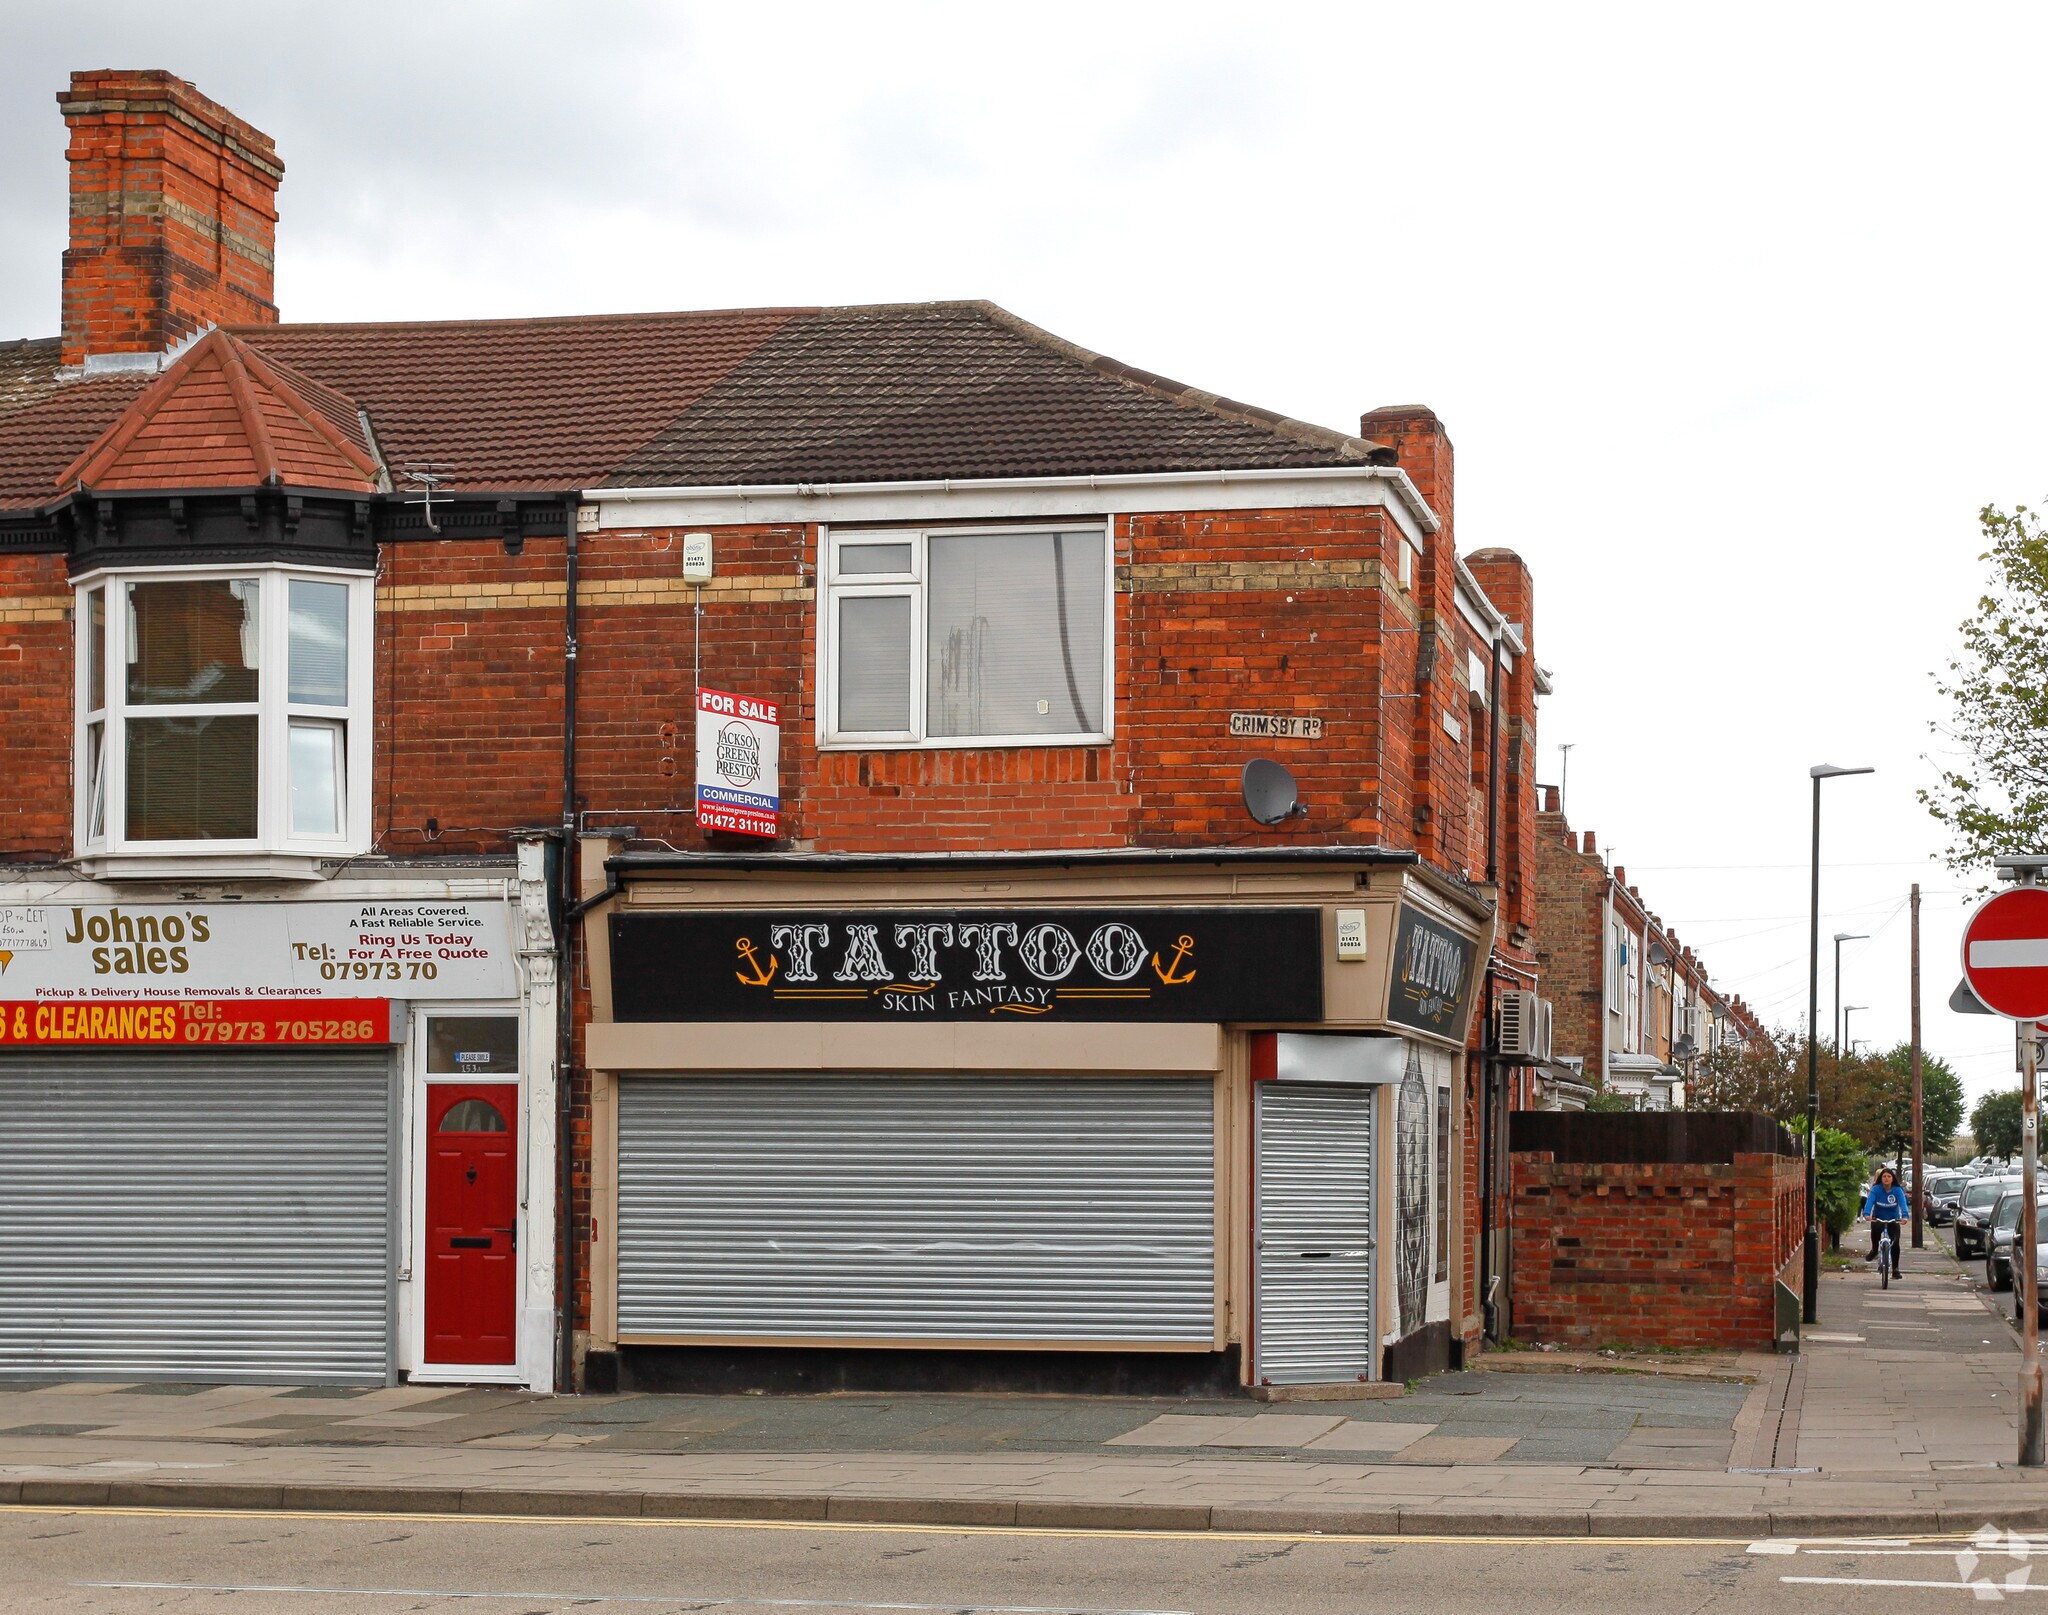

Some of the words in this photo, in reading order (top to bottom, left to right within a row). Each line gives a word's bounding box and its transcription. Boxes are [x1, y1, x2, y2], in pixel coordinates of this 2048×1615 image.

[702, 692, 734, 713] FOR
[739, 700, 777, 722] SALE
[717, 730, 760, 750] JACKSON
[716, 760, 761, 781] PRESTON
[703, 788, 773, 809] COMMERCIAL
[701, 813, 735, 829] 01472
[739, 818, 776, 835] 311120
[27, 909, 44, 922] LET
[361, 907, 376, 916] All
[380, 907, 414, 916] Areas
[417, 906, 469, 916] Covered.
[65, 907, 210, 943] Johno's
[349, 919, 358, 927] A
[362, 919, 385, 928] Fast
[389, 918, 433, 927] Reliable
[438, 918, 484, 927] Service.
[359, 934, 395, 947] Ring
[401, 934, 420, 945] Us
[426, 933, 473, 947] Today
[92, 943, 189, 974] sales
[292, 943, 336, 960] Tel:
[349, 949, 374, 959] For
[380, 949, 392, 959] A
[398, 948, 432, 959] Free
[438, 948, 488, 961] Quote
[771, 923, 1149, 981] TATTOO
[1409, 924, 1461, 997] TATTOO
[320, 962, 401, 980] 07973
[407, 962, 437, 980] 70
[36, 988, 74, 998] Pickup
[79, 988, 87, 996] &
[92, 987, 139, 998] Delivery
[144, 987, 180, 997] House
[184, 986, 240, 996] Removals
[245, 987, 253, 996] &
[258, 986, 321, 996] Clearances
[882, 993, 935, 1011] SKIN
[948, 986, 1051, 1009] FANTASY
[179, 1001, 222, 1020] Tel:
[13, 1007, 28, 1039] &
[36, 1007, 176, 1040] CLEARANCES
[185, 1022, 265, 1041] 07973
[276, 1021, 374, 1040] 705286
